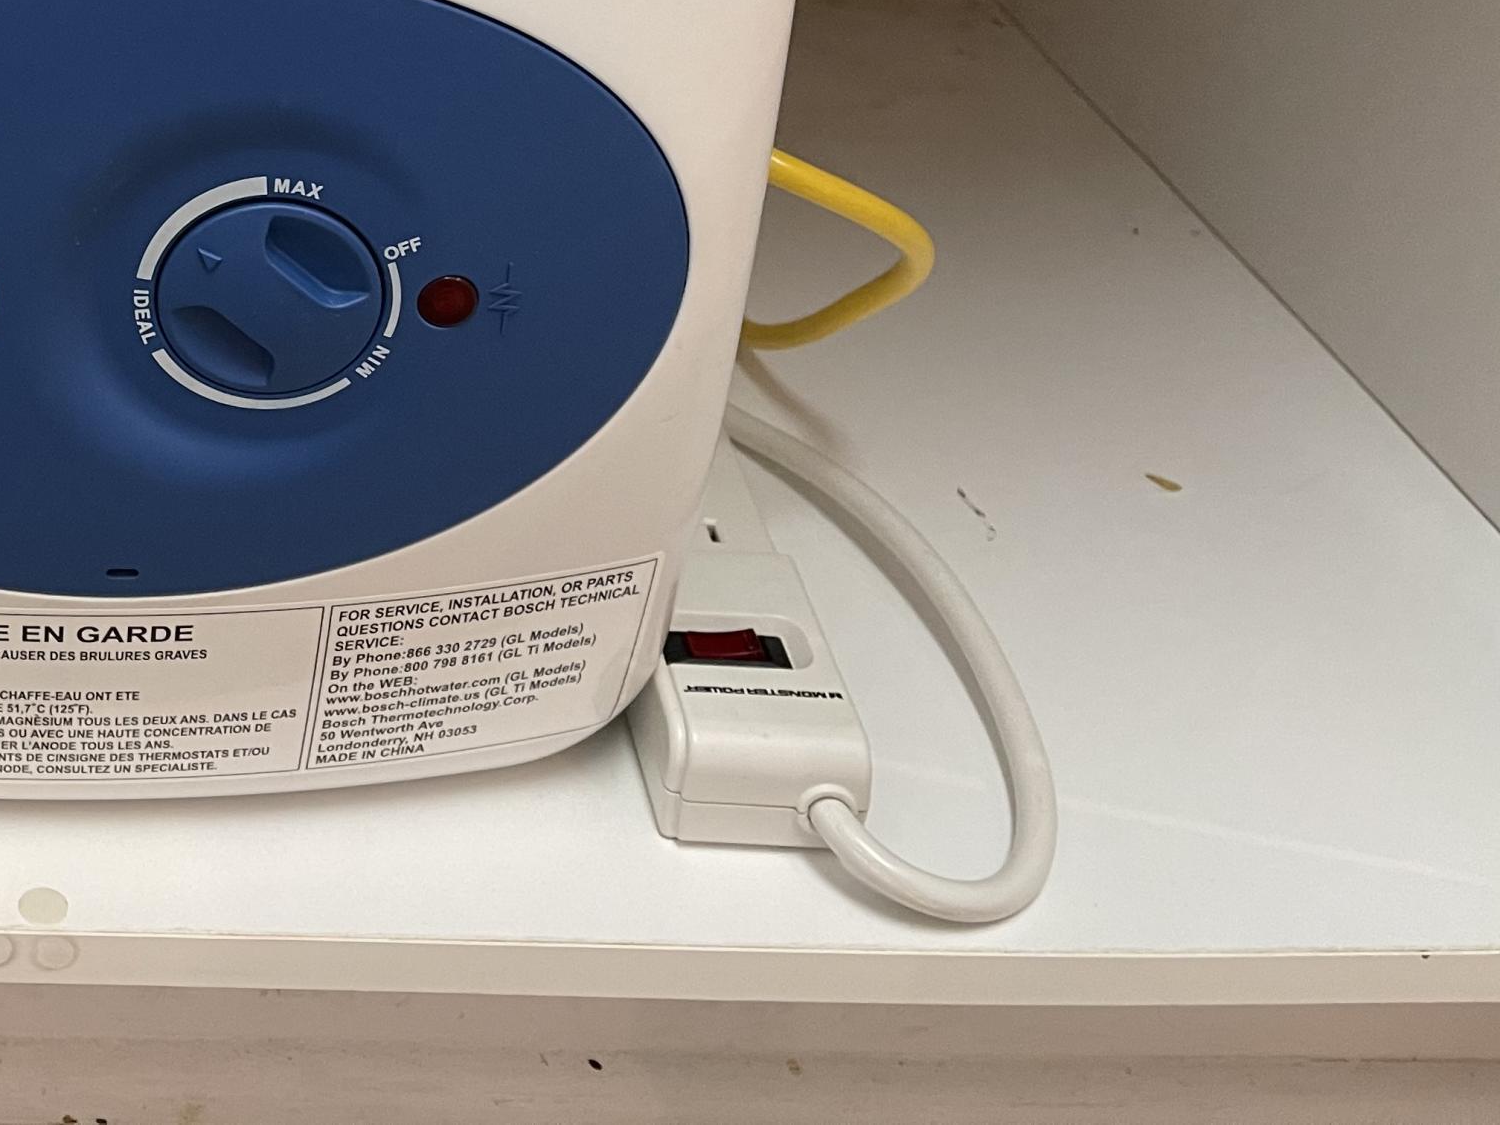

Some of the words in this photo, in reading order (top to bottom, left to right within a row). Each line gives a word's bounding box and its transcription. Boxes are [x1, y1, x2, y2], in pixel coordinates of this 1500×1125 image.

[274, 179, 323, 199] MAX
[385, 237, 421, 259] OFF
[134, 290, 156, 344] IDEAL
[356, 345, 390, 377] MIN
[339, 609, 370, 622] FOR
[375, 601, 443, 618] SERVICE,
[448, 585, 556, 610] INSTALLATION,
[562, 581, 582, 593] OR
[587, 571, 633, 589] PARTS
[337, 618, 424, 636] QUESTIONS
[429, 608, 500, 627] CONTACT
[504, 599, 555, 617] BOSCH
[561, 582, 639, 608] TECHNICAL
[22, 626, 64, 642] EN
[77, 625, 193, 643] GARDE
[335, 636, 406, 652] SERVICE:
[50, 651, 75, 660] DES
[80, 651, 150, 661] BRULURES
[155, 650, 207, 660] GRAVES
[333, 656, 351, 668] By
[356, 646, 431, 663] Phone:866
[436, 643, 459, 654] 330
[464, 638, 496, 651] 2729
[501, 634, 525, 648] (GL
[530, 623, 584, 641] Models)
[747, 688, 827, 699] MONSTER
